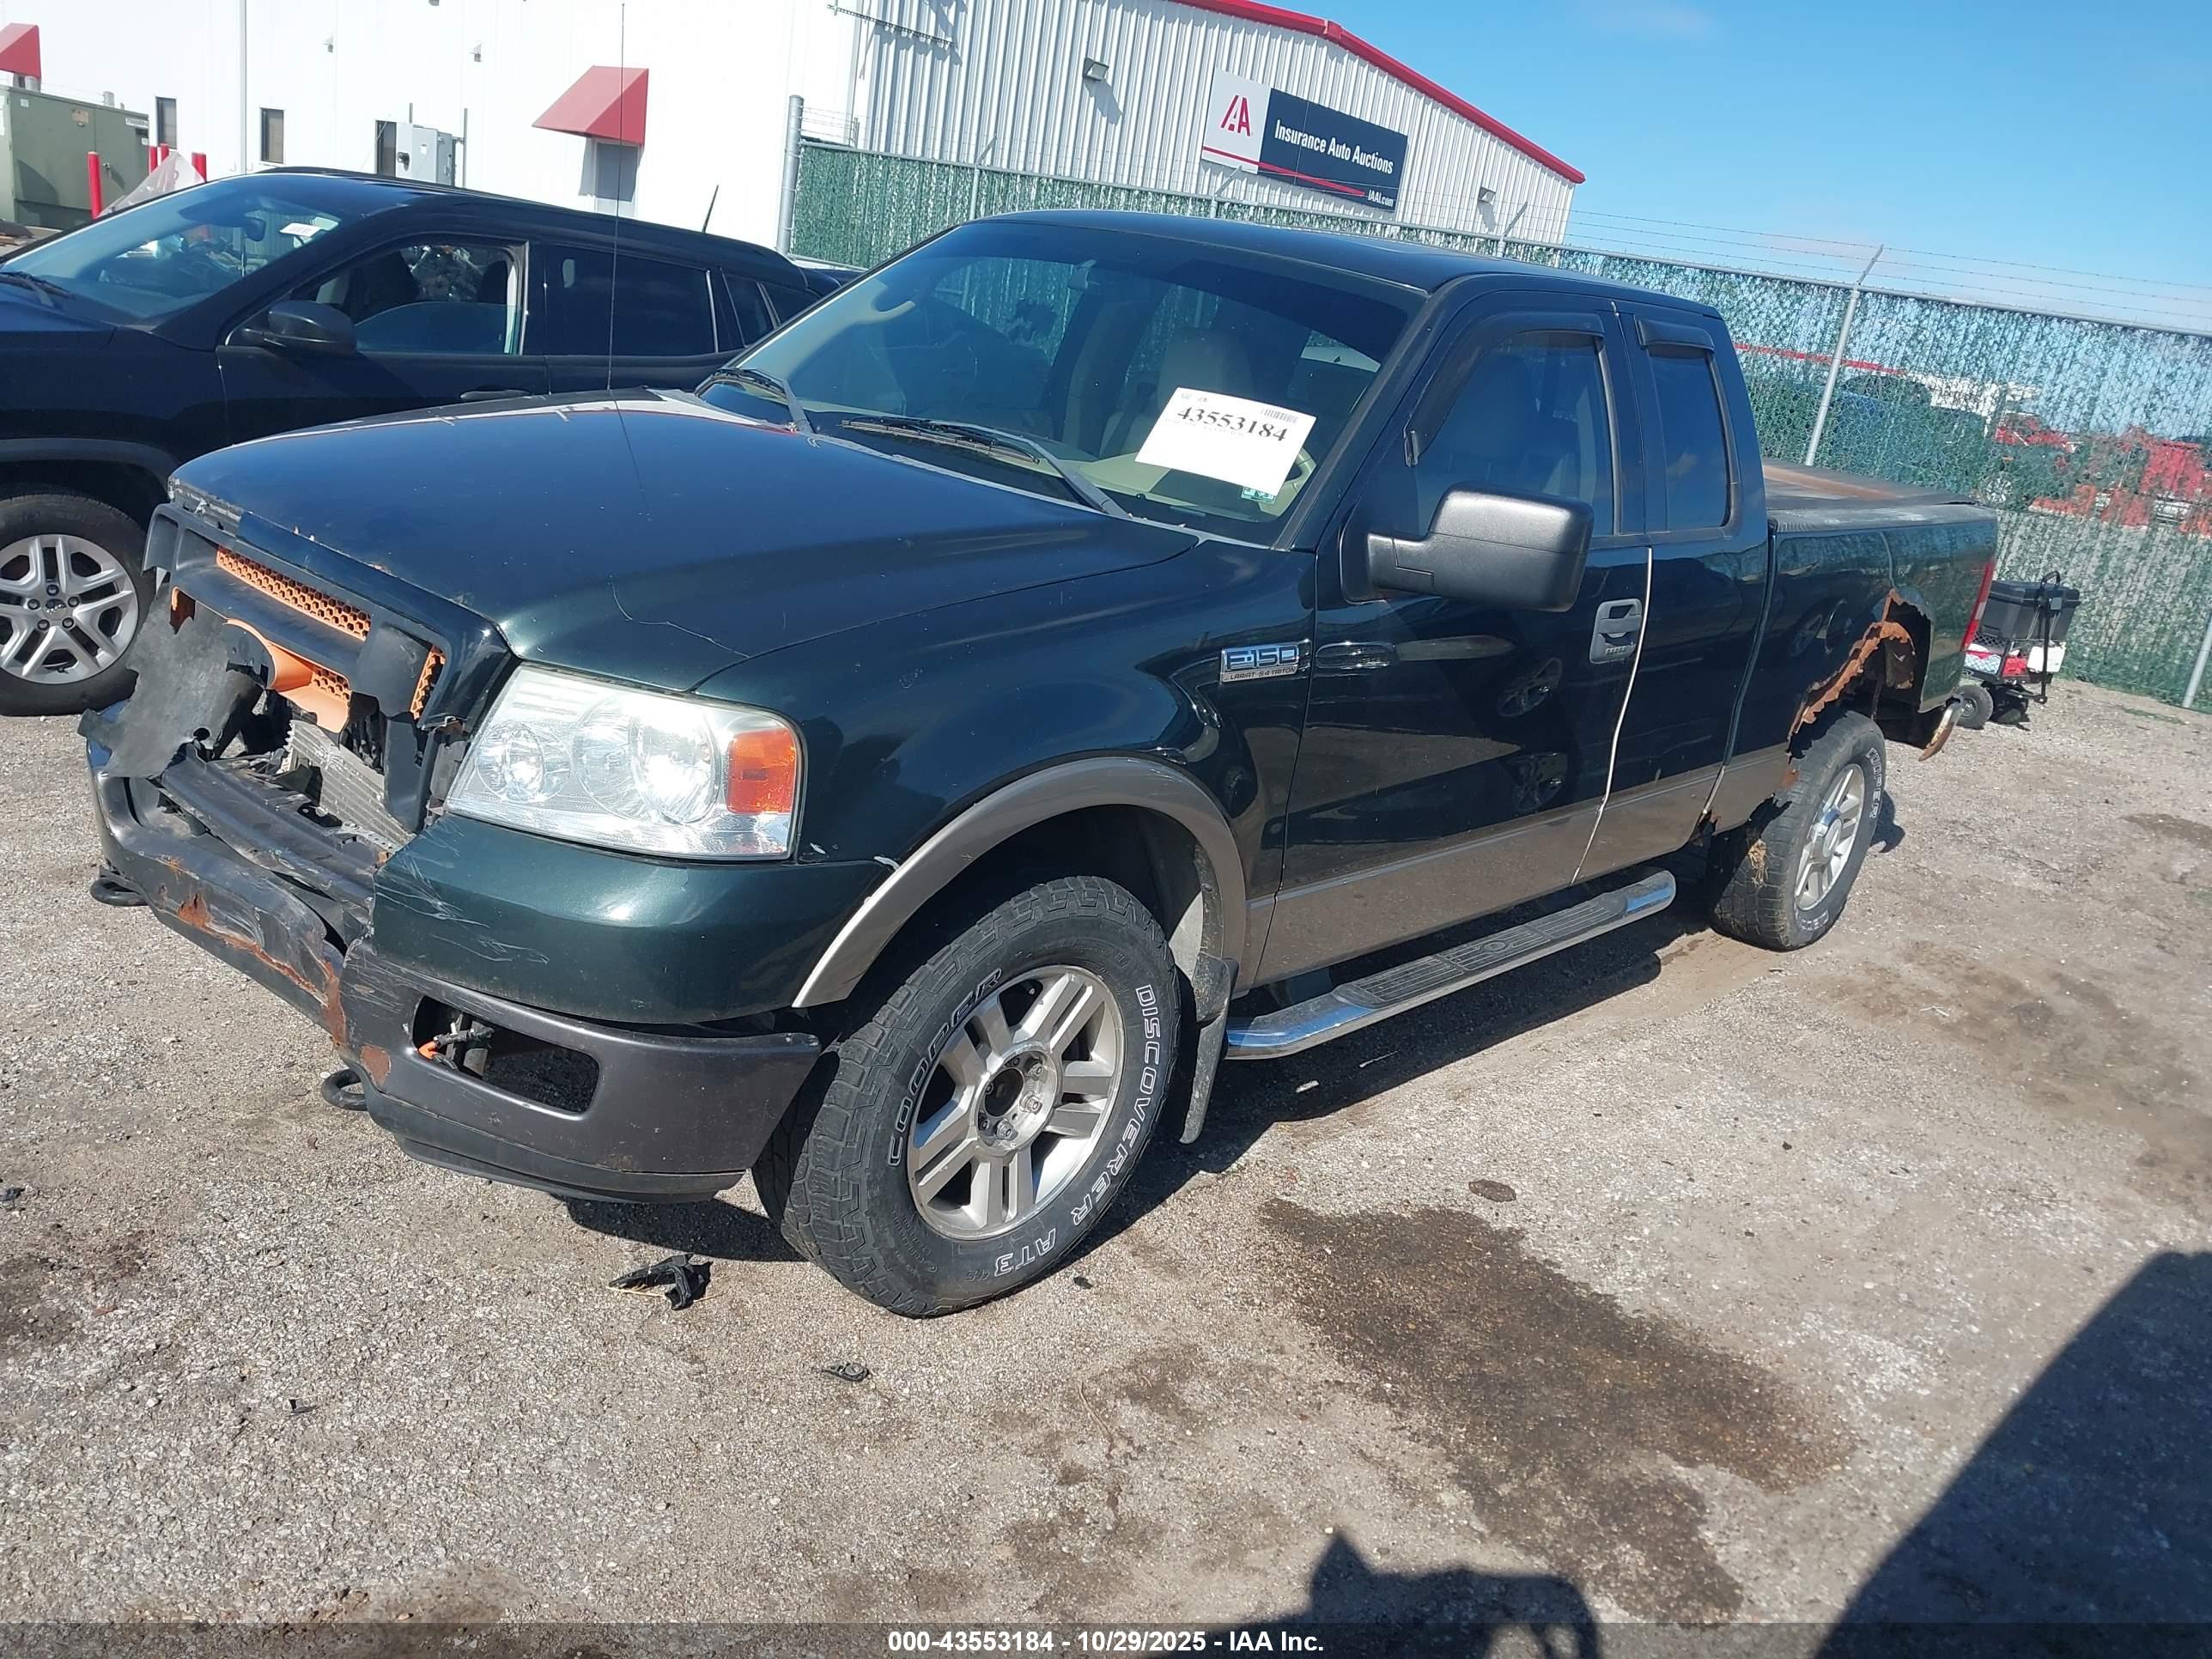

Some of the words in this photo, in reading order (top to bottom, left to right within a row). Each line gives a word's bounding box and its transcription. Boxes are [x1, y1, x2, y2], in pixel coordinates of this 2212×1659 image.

[1274, 118, 1327, 153] Insurance
[1328, 137, 1351, 161] Auto
[1352, 144, 1394, 174] Auctions
[1177, 406, 1288, 442] 43553184
[1224, 645, 1299, 671] F-150
[1271, 665, 1297, 676] TRITON
[888, 967, 1003, 1167] COOPER
[1070, 983, 1162, 1227] DISCOVERER
[993, 1227, 1056, 1279] AT3
